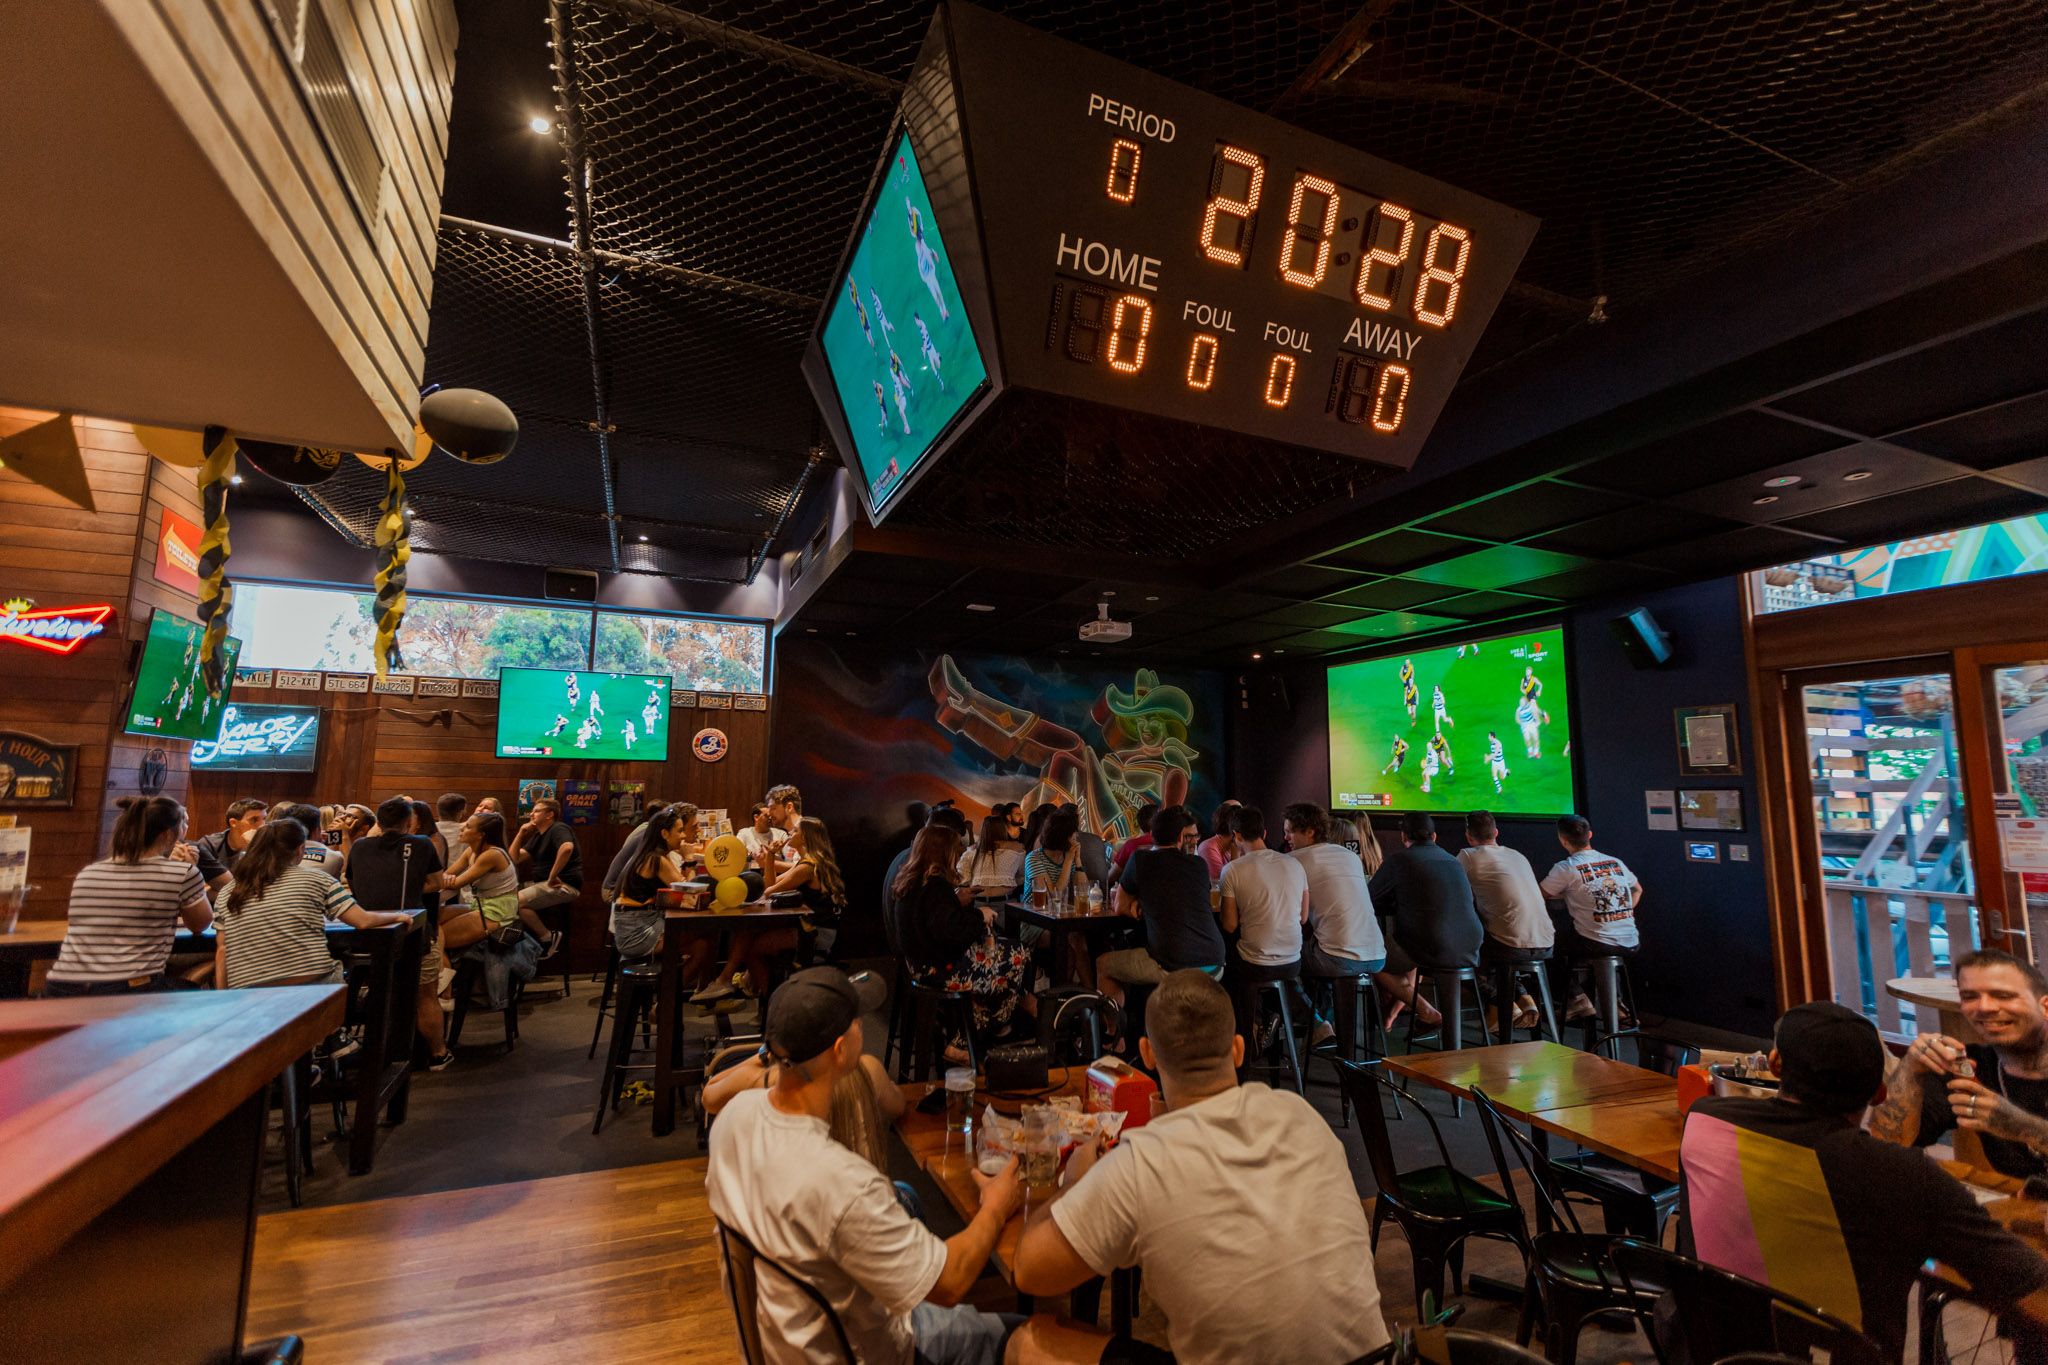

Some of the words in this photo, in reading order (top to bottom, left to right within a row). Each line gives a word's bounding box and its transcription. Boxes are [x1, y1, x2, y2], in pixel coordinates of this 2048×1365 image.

[1088, 93, 1176, 143] PERIOD
[1107, 140, 1141, 201] 0
[1056, 232, 1162, 292] HOME
[1183, 300, 1236, 333] FOUL
[1263, 321, 1312, 353] FOUL
[1343, 317, 1422, 361] AWAY
[1187, 334, 1219, 389] 0
[1265, 354, 1296, 407] 0
[348, 680, 366, 690] 664
[565, 794, 598, 802] GRAND
[567, 800, 594, 808] FINAL
[403, 843, 412, 858] 5
[1345, 841, 1358, 854] 52
